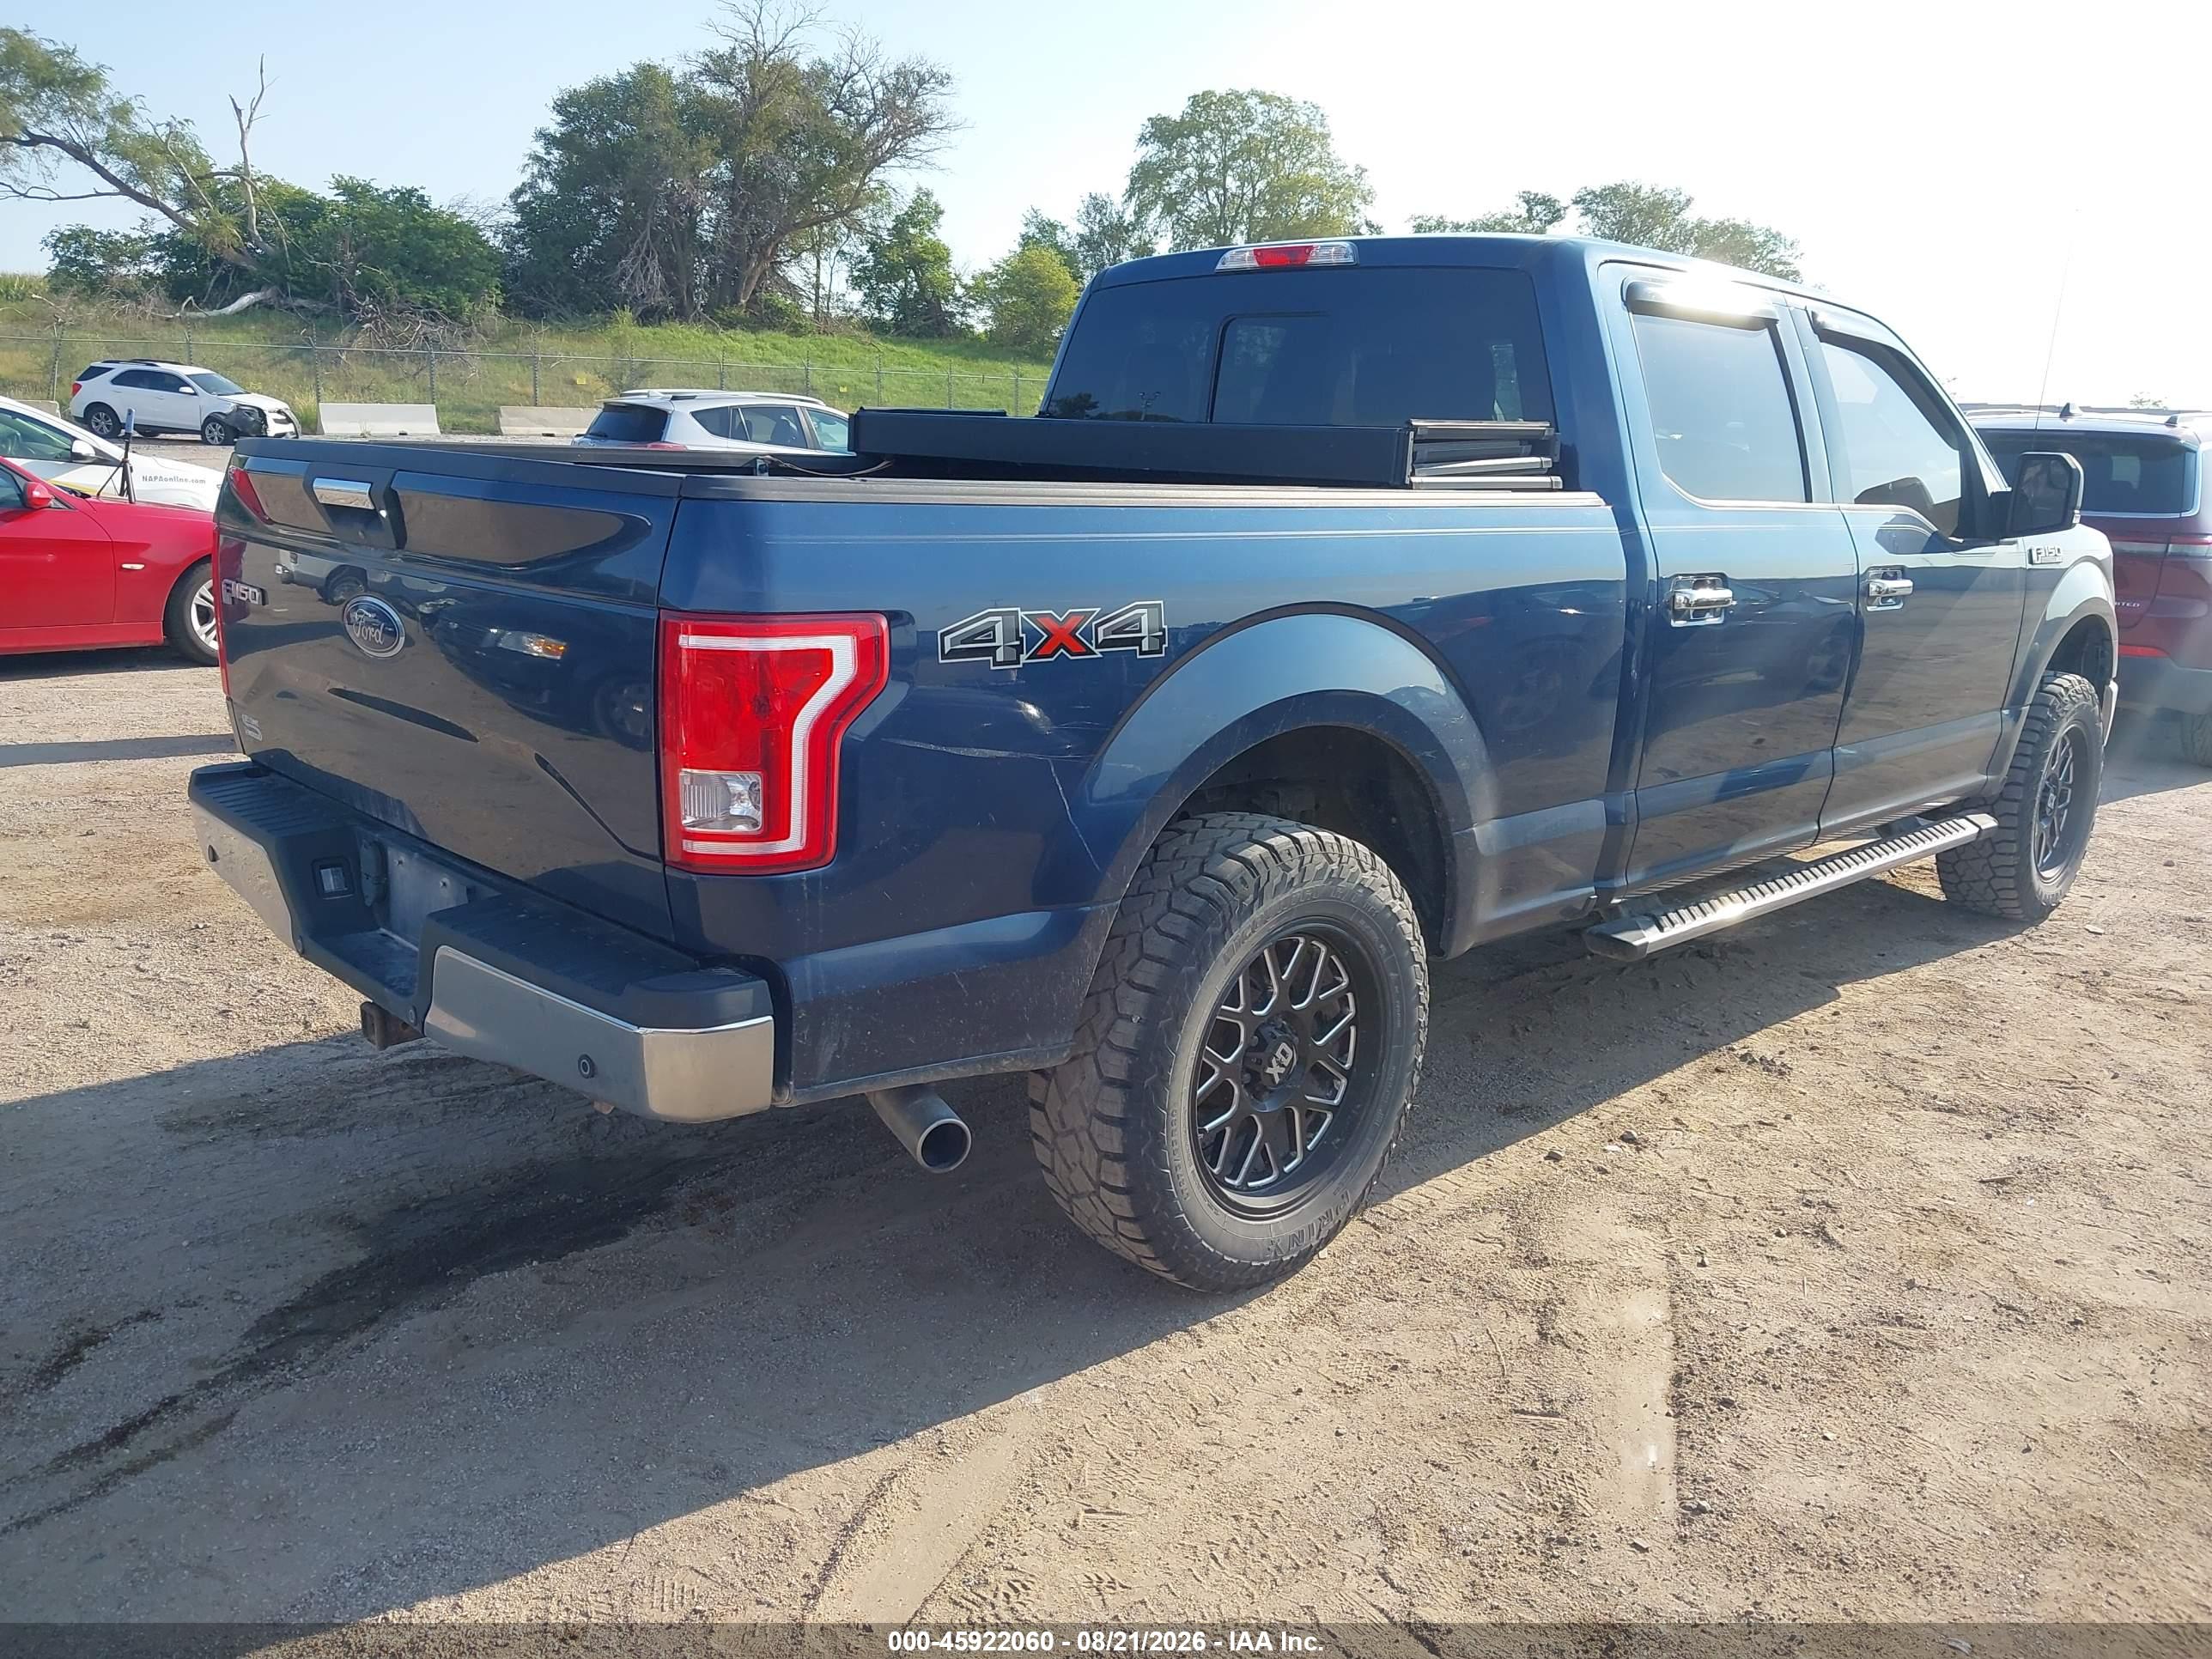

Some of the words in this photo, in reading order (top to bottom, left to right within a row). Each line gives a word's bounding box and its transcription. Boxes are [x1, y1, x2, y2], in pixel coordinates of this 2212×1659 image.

[142, 474, 206, 484] NAPAonline.com
[352, 608, 386, 645] Ford
[1267, 1189, 1351, 1256] PRINX
